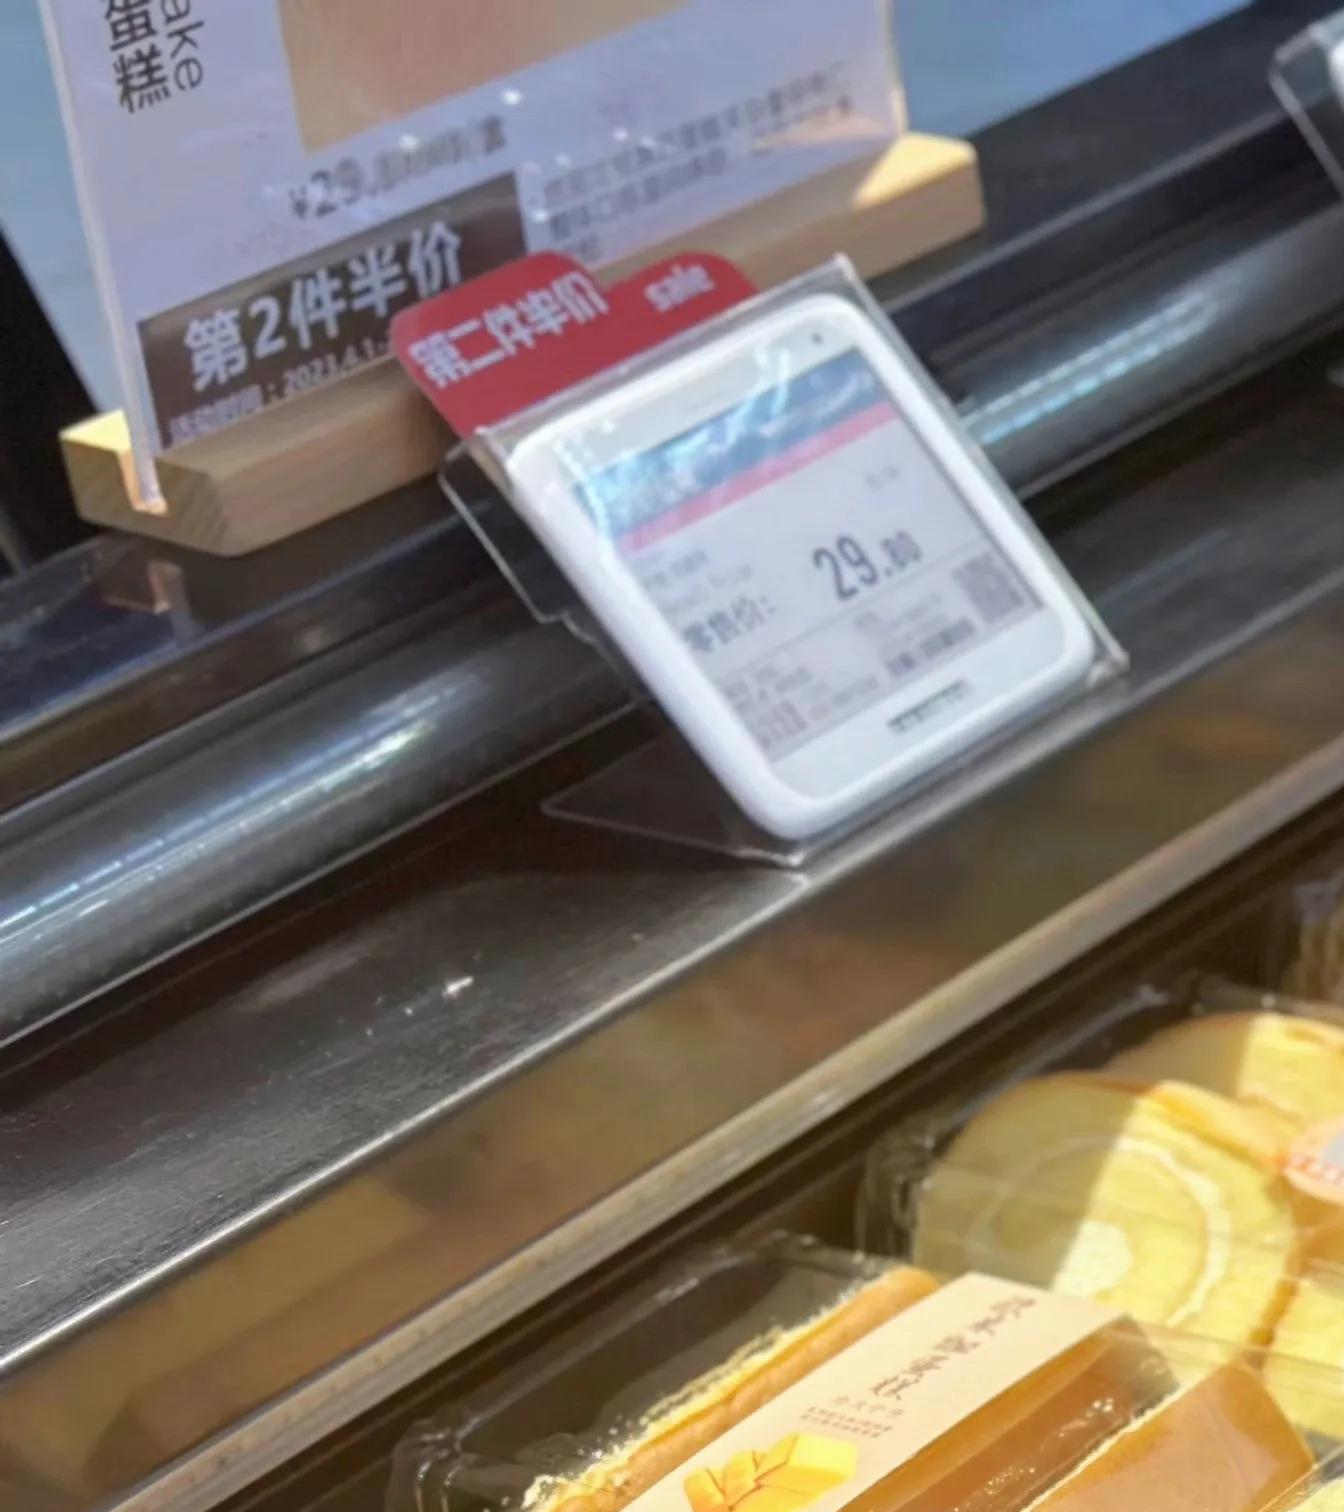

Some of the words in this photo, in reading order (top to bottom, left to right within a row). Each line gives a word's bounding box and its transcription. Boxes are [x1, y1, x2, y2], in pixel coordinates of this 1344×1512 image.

[183, 220, 461, 391] 第2件半价
[407, 270, 609, 389] 第二件半价
